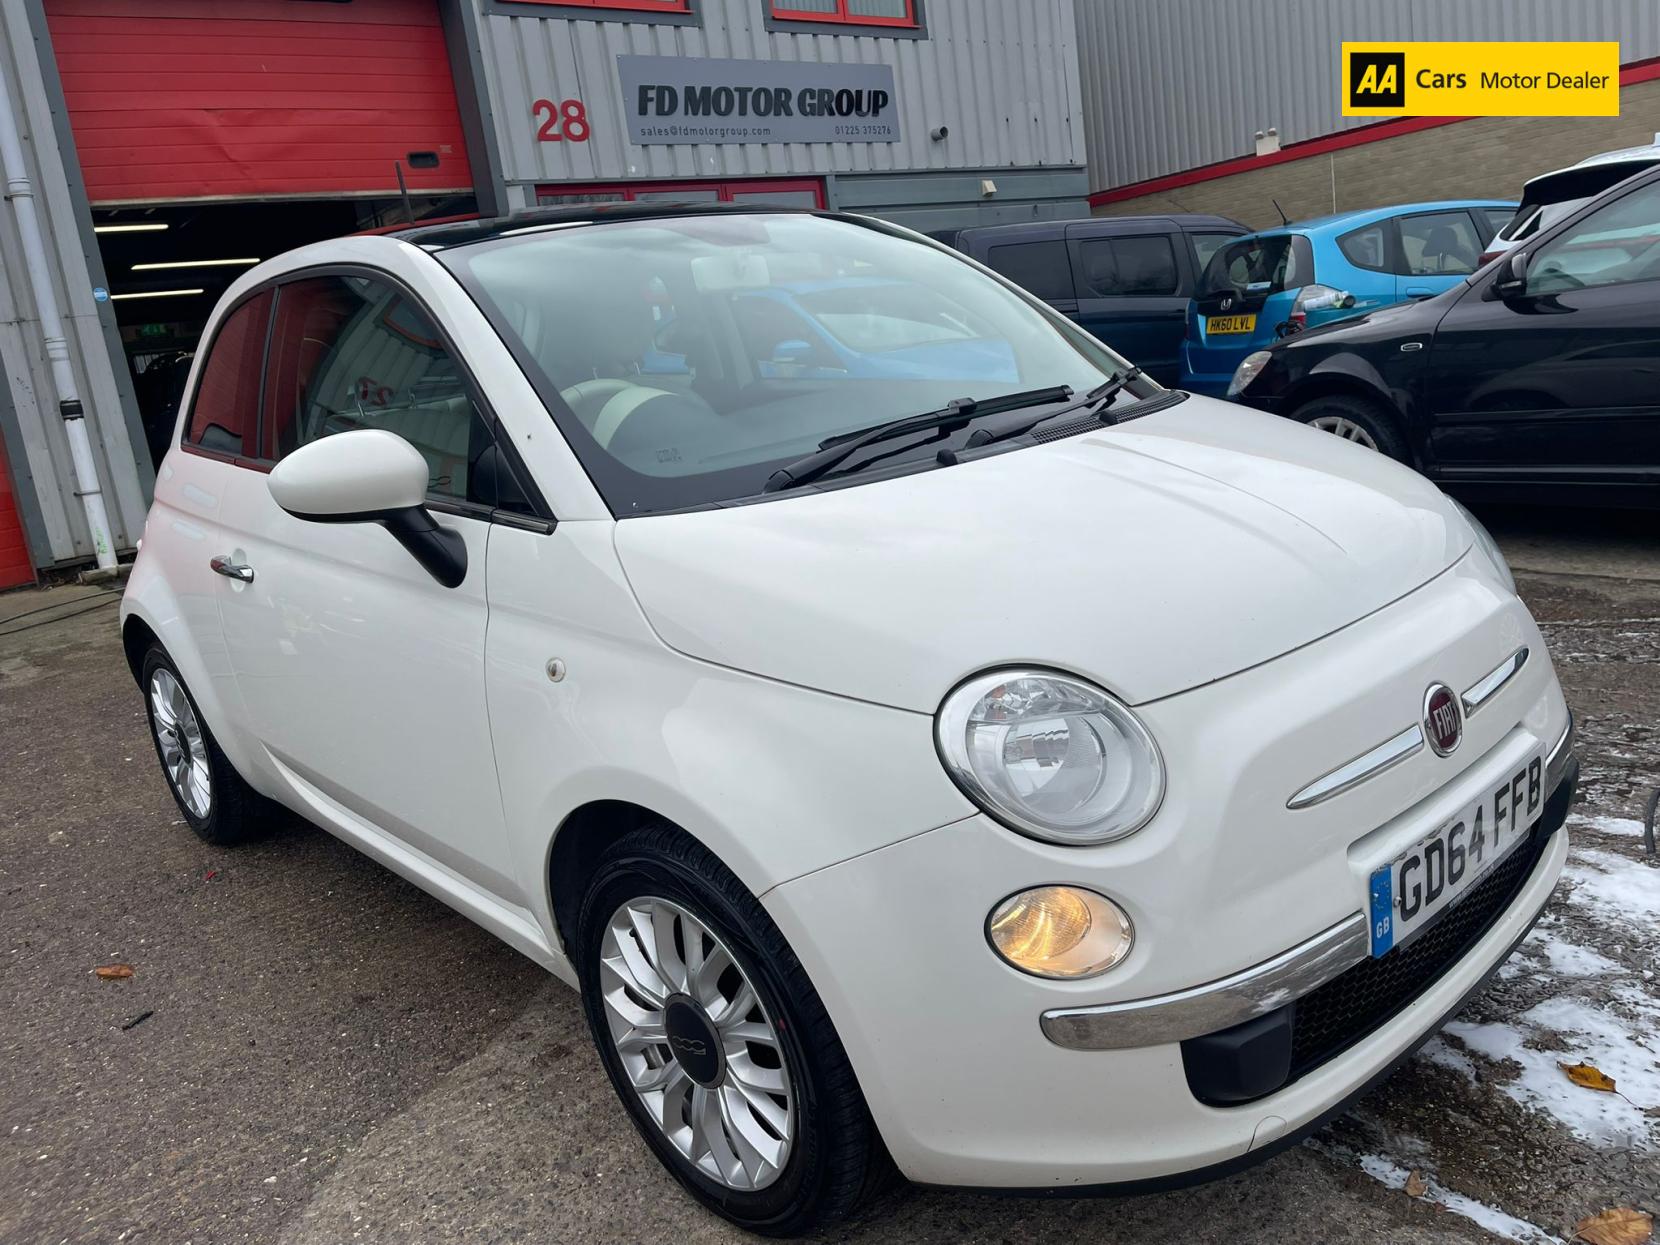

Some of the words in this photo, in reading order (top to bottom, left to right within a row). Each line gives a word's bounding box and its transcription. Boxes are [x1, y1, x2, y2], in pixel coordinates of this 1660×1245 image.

[638, 85, 679, 116] FD
[684, 86, 793, 117] MOTOR
[797, 88, 889, 118] GROUP
[532, 98, 591, 143] 28
[640, 126, 771, 138] sales@fdmotorgroup.com
[834, 125, 860, 135] 01225
[1210, 318, 1233, 332] HK60
[1233, 316, 1251, 330] LVL
[1433, 701, 1460, 740] FIAT
[1399, 803, 1486, 922] GD64
[1493, 755, 1542, 848] FFB
[1376, 916, 1390, 939] GB
